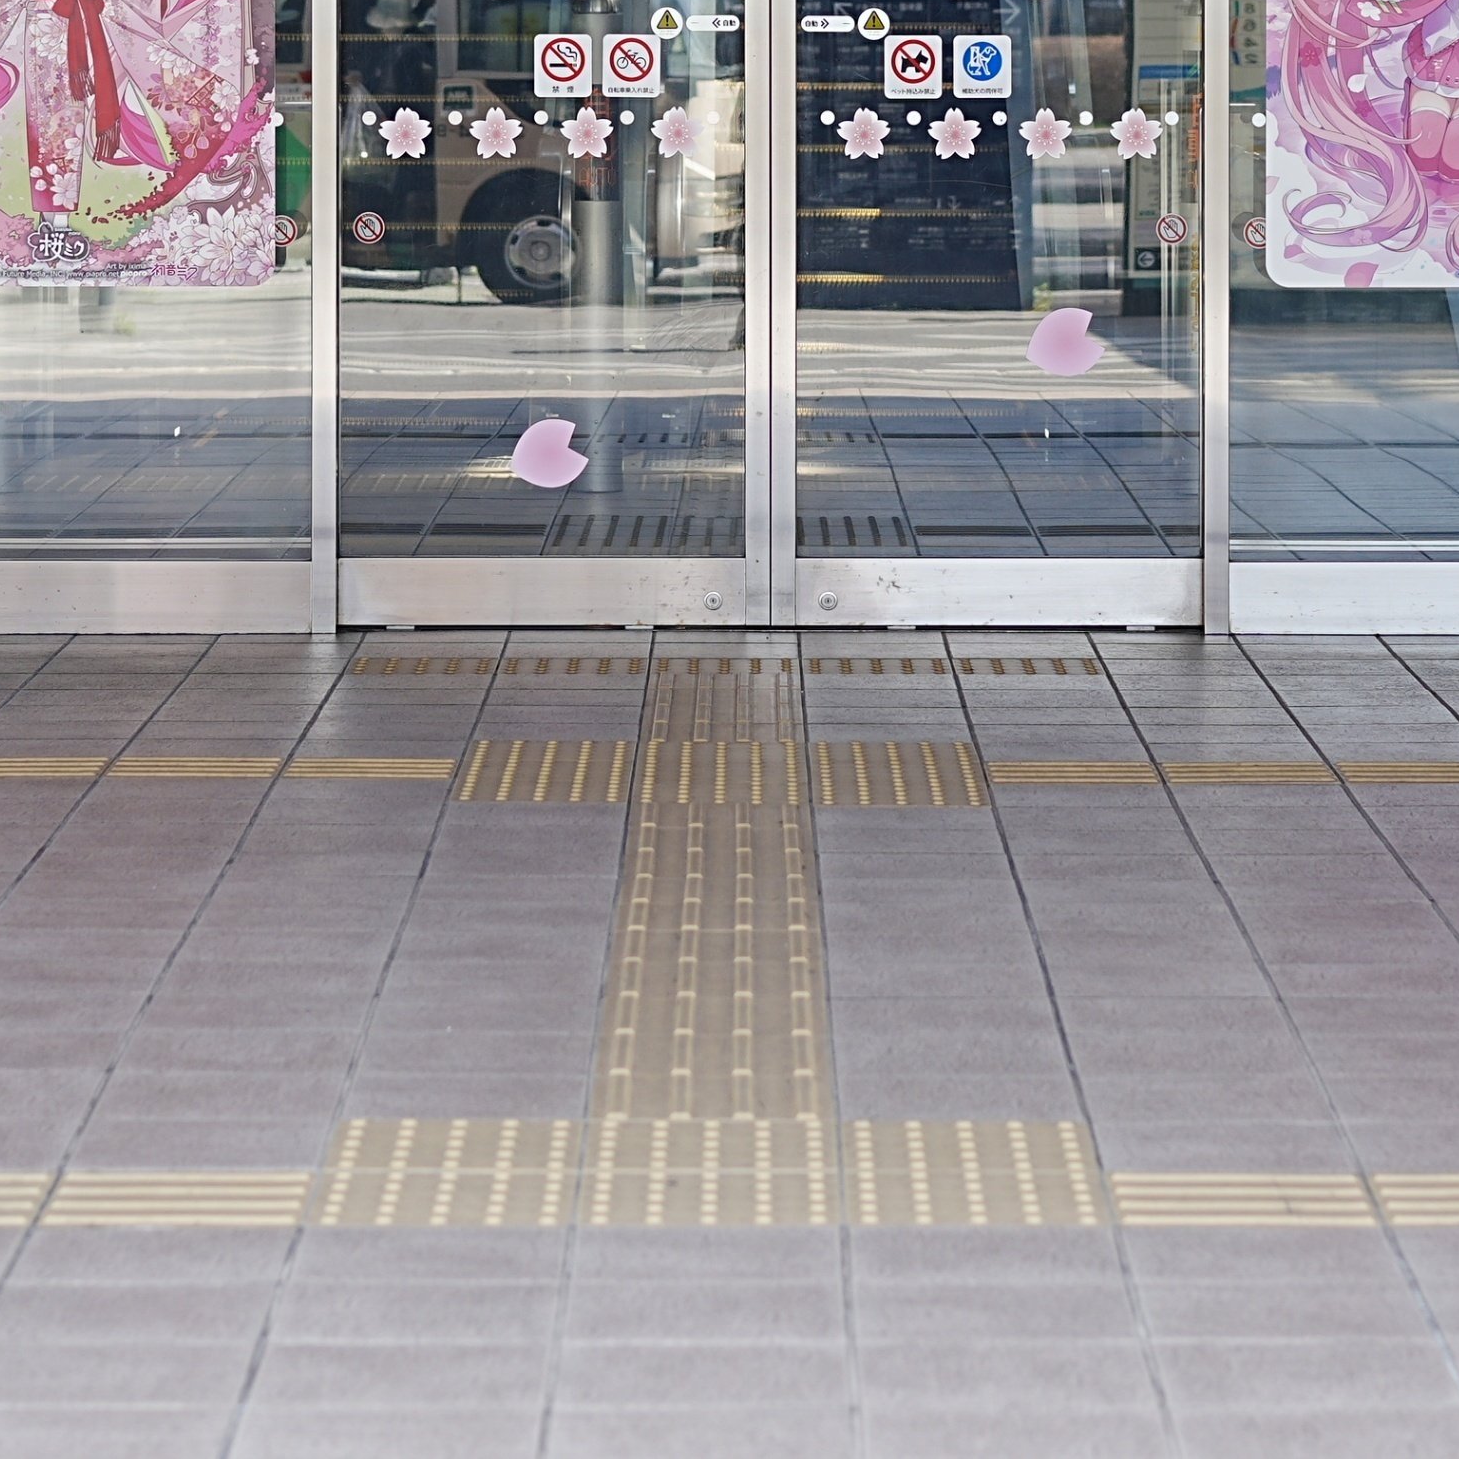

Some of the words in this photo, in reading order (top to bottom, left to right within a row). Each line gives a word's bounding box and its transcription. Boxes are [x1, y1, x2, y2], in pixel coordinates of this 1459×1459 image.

[38, 232, 85, 256] 桜ミク
[151, 263, 198, 281] 初音ミク
